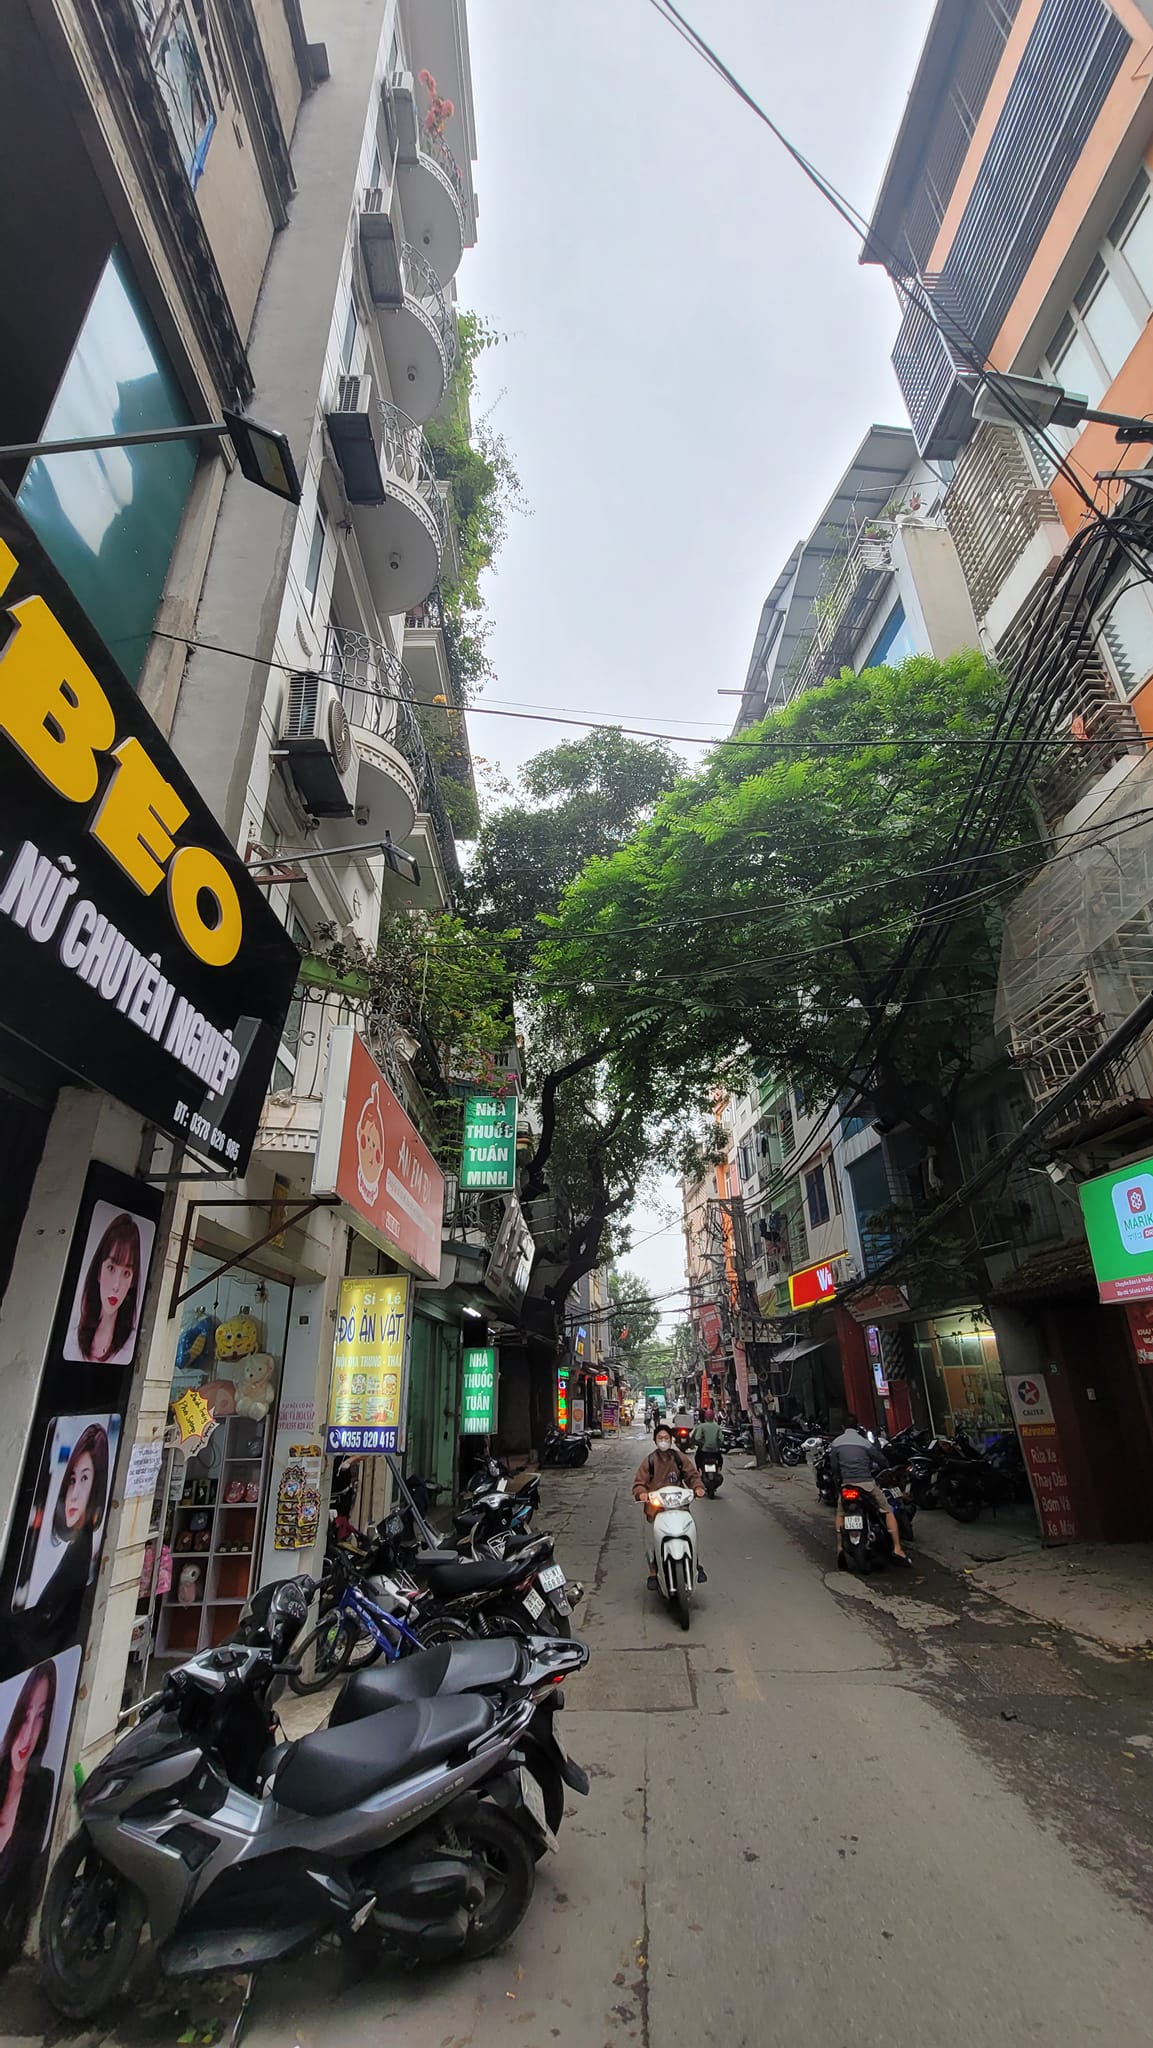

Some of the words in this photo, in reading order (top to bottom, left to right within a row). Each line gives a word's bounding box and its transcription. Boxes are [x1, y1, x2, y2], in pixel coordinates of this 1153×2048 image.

[59, 900, 175, 1041] CHUYÊN
[164, 996, 240, 1101] NGHIỆP
[190, 1112, 211, 1141] 0378
[210, 1127, 226, 1152] 626
[225, 1138, 241, 1161] 985
[469, 1142, 508, 1162] TUẤN
[467, 1171, 508, 1185] MINH
[469, 1350, 488, 1368] NHÀ
[464, 1368, 493, 1388] THUỐC
[466, 1390, 490, 1411] TUẤN
[464, 1417, 489, 1433] MINH
[341, 1431, 361, 1448] 0355
[362, 1431, 378, 1448] 820
[380, 1431, 395, 1448] 415
